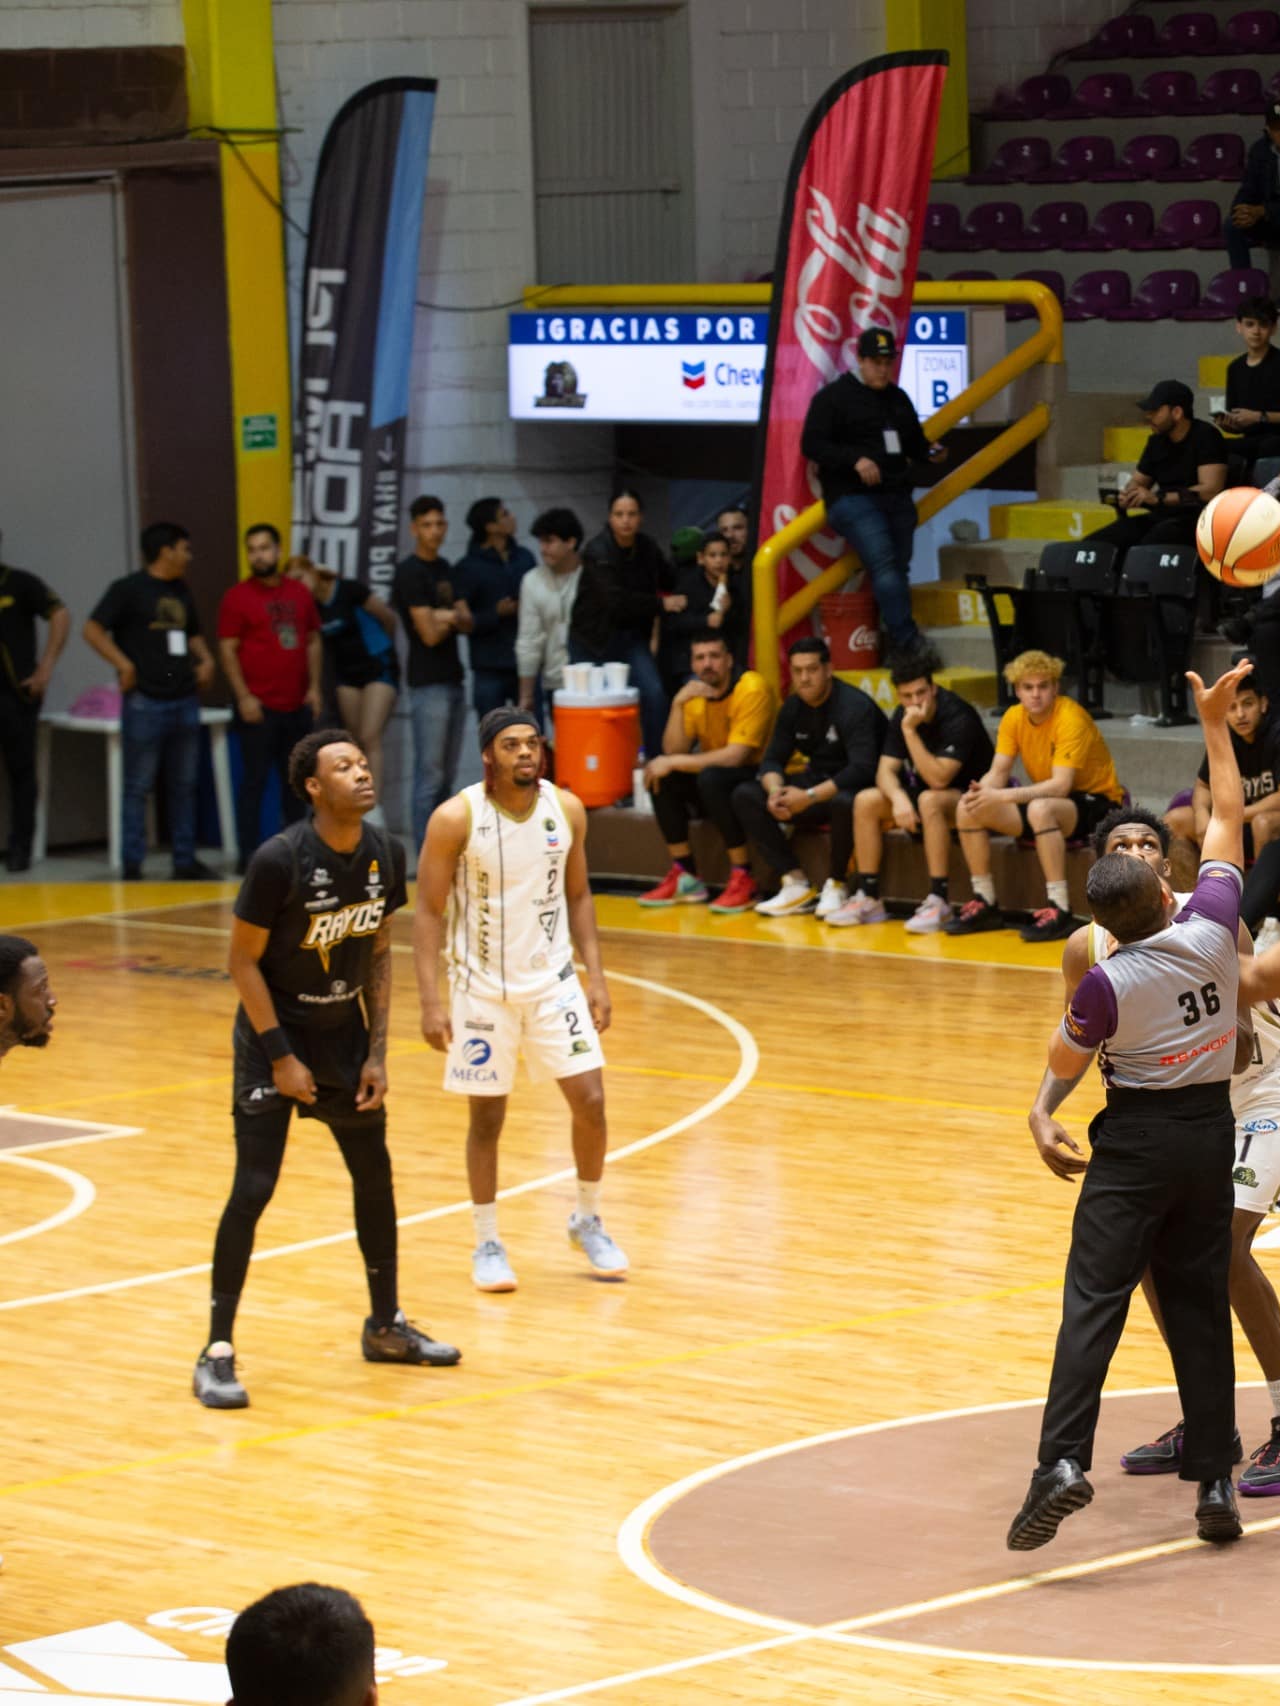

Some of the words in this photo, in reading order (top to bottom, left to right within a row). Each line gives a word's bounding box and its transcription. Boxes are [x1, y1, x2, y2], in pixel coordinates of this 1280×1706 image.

[535, 318, 681, 341] ¡GRACIAS
[697, 318, 756, 341] POR
[922, 357, 958, 373] ZONA
[932, 380, 950, 408] B
[1067, 511, 1084, 538] J
[1075, 550, 1097, 564] R3
[1159, 553, 1180, 568] R4
[547, 868, 558, 895] 2
[303, 897, 388, 949] RAYOS
[1177, 982, 1221, 1027] 36
[565, 1011, 582, 1036] 2
[451, 1066, 498, 1082] MEGA
